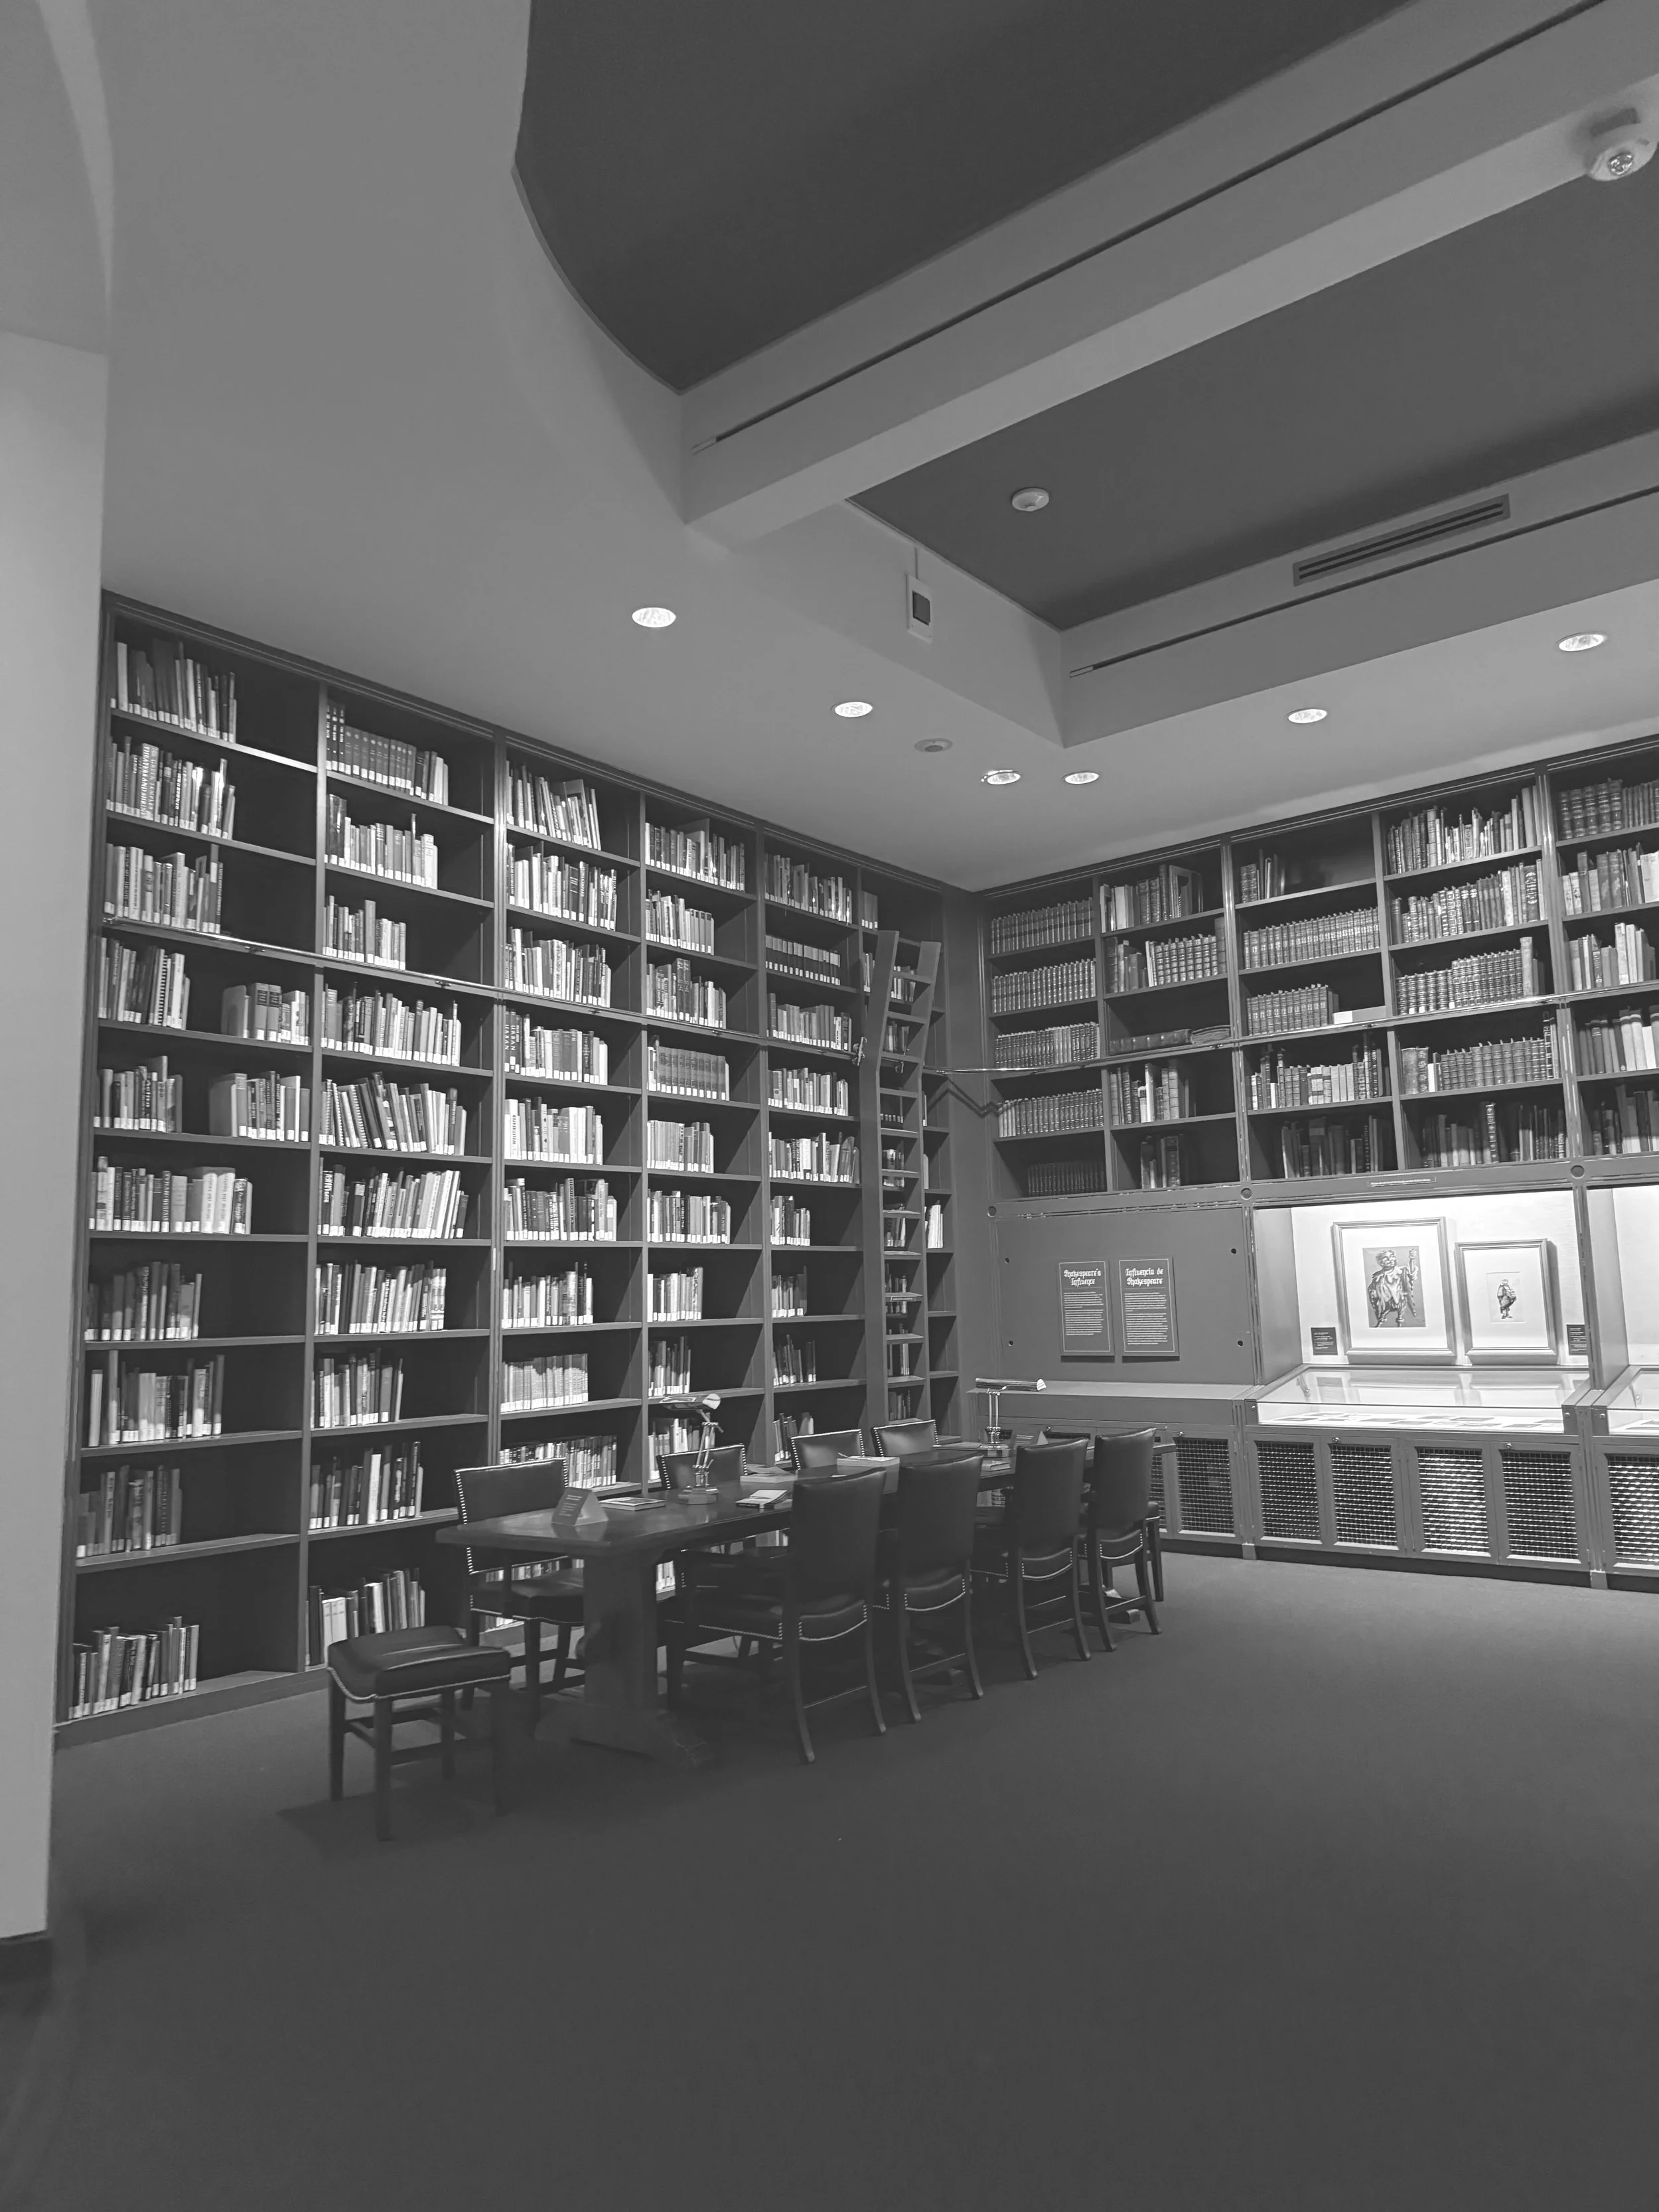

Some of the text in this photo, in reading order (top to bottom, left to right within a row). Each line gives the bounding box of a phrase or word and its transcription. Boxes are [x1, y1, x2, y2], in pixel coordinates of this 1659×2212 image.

[1064, 1268, 1102, 1278] Shakespeare's
[1125, 1268, 1155, 1278] Influencia
[1071, 1278, 1096, 1288] Influence
[1126, 1278, 1163, 1287] Shakespeare
